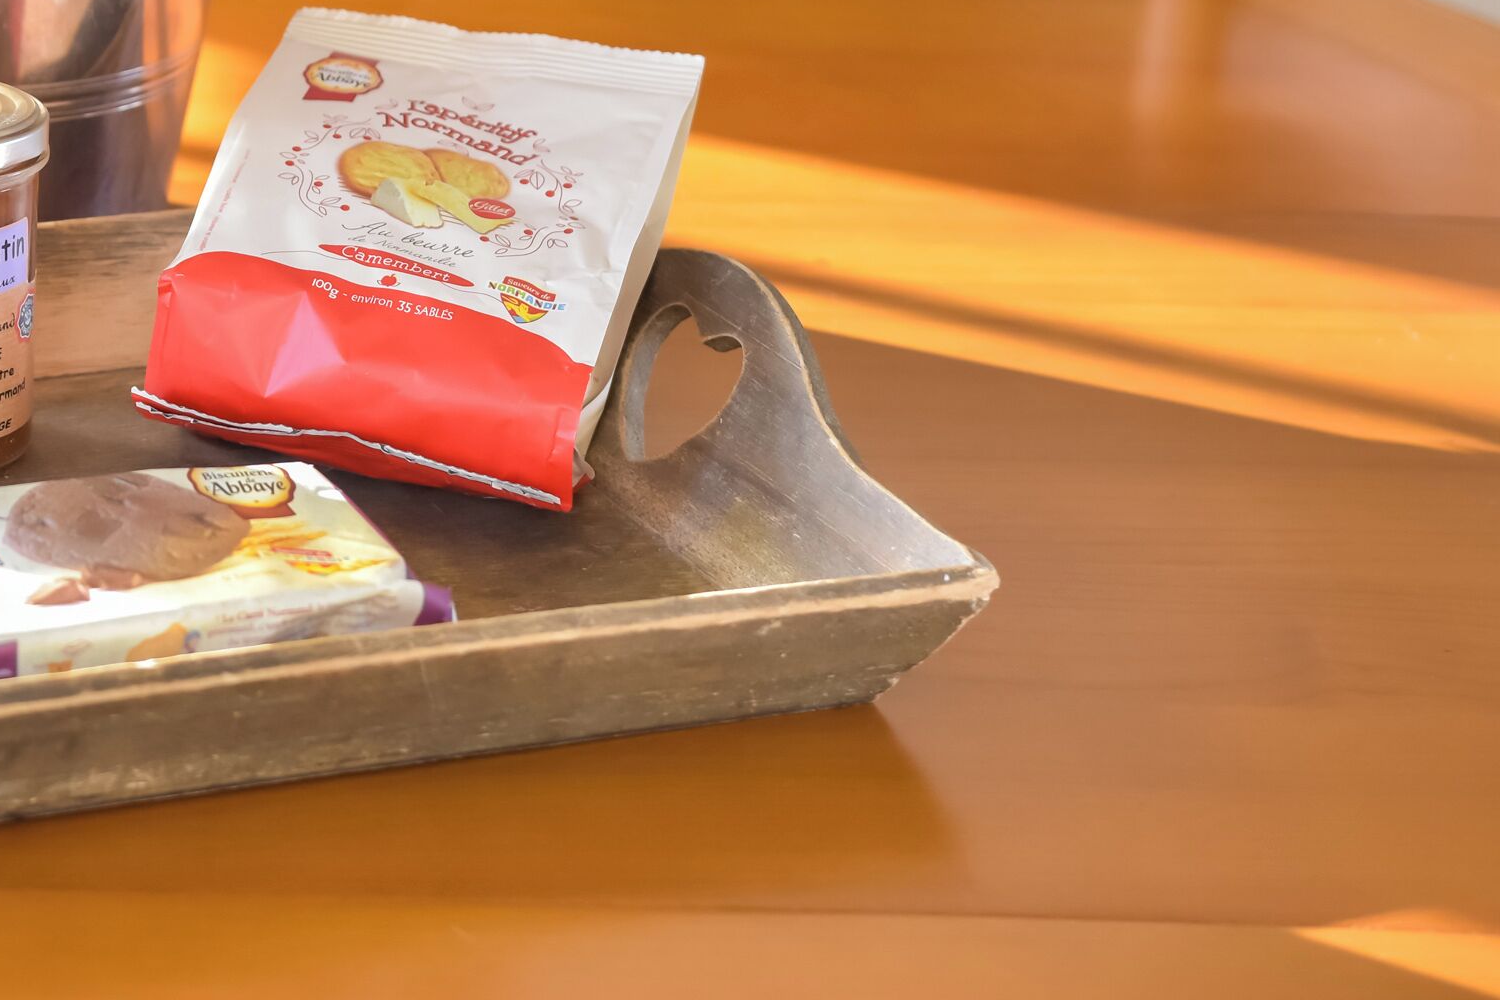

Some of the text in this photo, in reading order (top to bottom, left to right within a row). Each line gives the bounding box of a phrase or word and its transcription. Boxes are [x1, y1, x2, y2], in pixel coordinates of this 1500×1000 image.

[376, 112, 539, 166] Normand
[341, 221, 476, 258] Au beurre
[341, 246, 451, 282] Camembert
[311, 278, 340, 300] 100g
[351, 292, 393, 309] environ
[396, 300, 412, 314] 35
[414, 304, 454, 321] SABLÉS
[488, 281, 566, 310] NORMANDIE
[506, 278, 551, 301] Saveurs de
